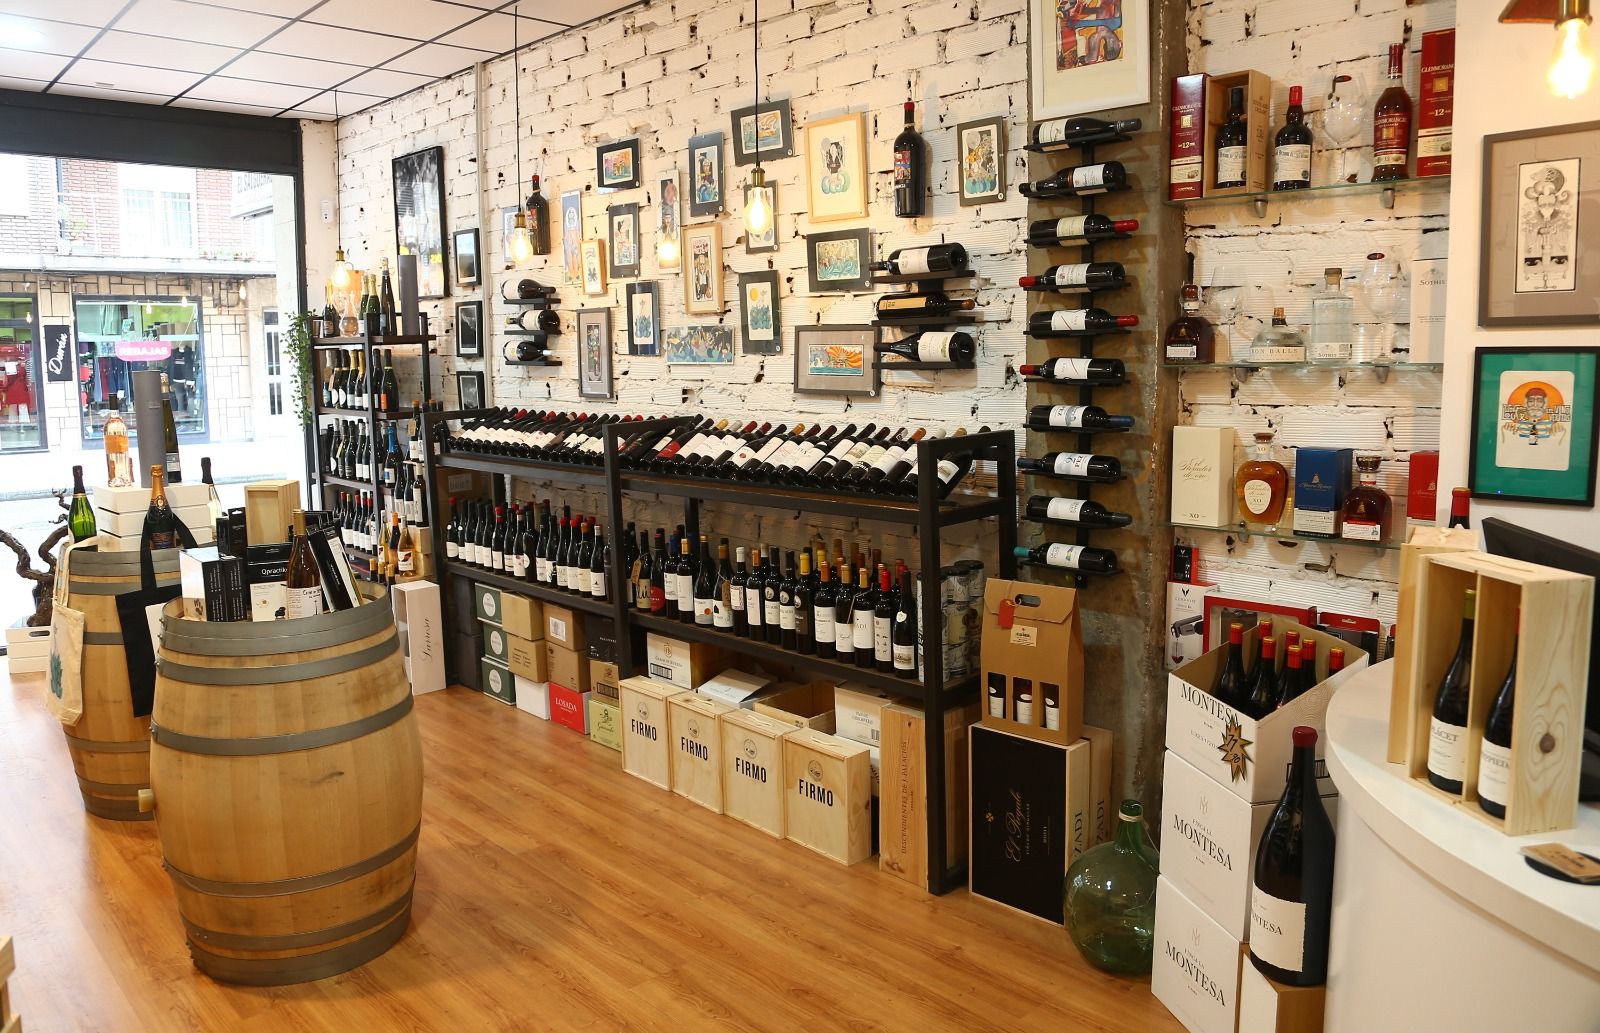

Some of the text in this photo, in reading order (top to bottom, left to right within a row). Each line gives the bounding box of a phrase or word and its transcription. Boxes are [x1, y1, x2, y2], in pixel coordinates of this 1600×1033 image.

[1434, 108, 1445, 117] 12
[1182, 141, 1190, 149] 12
[120, 346, 169, 356] REBAJAS
[555, 697, 577, 712] LOSADA
[631, 718, 657, 741] FIRMO
[681, 736, 708, 761] FIRMO
[735, 757, 767, 783] FIRMO
[799, 778, 834, 807] FIRMO
[1174, 813, 1232, 871] MONTESA
[1165, 940, 1225, 1007] MONTESA
